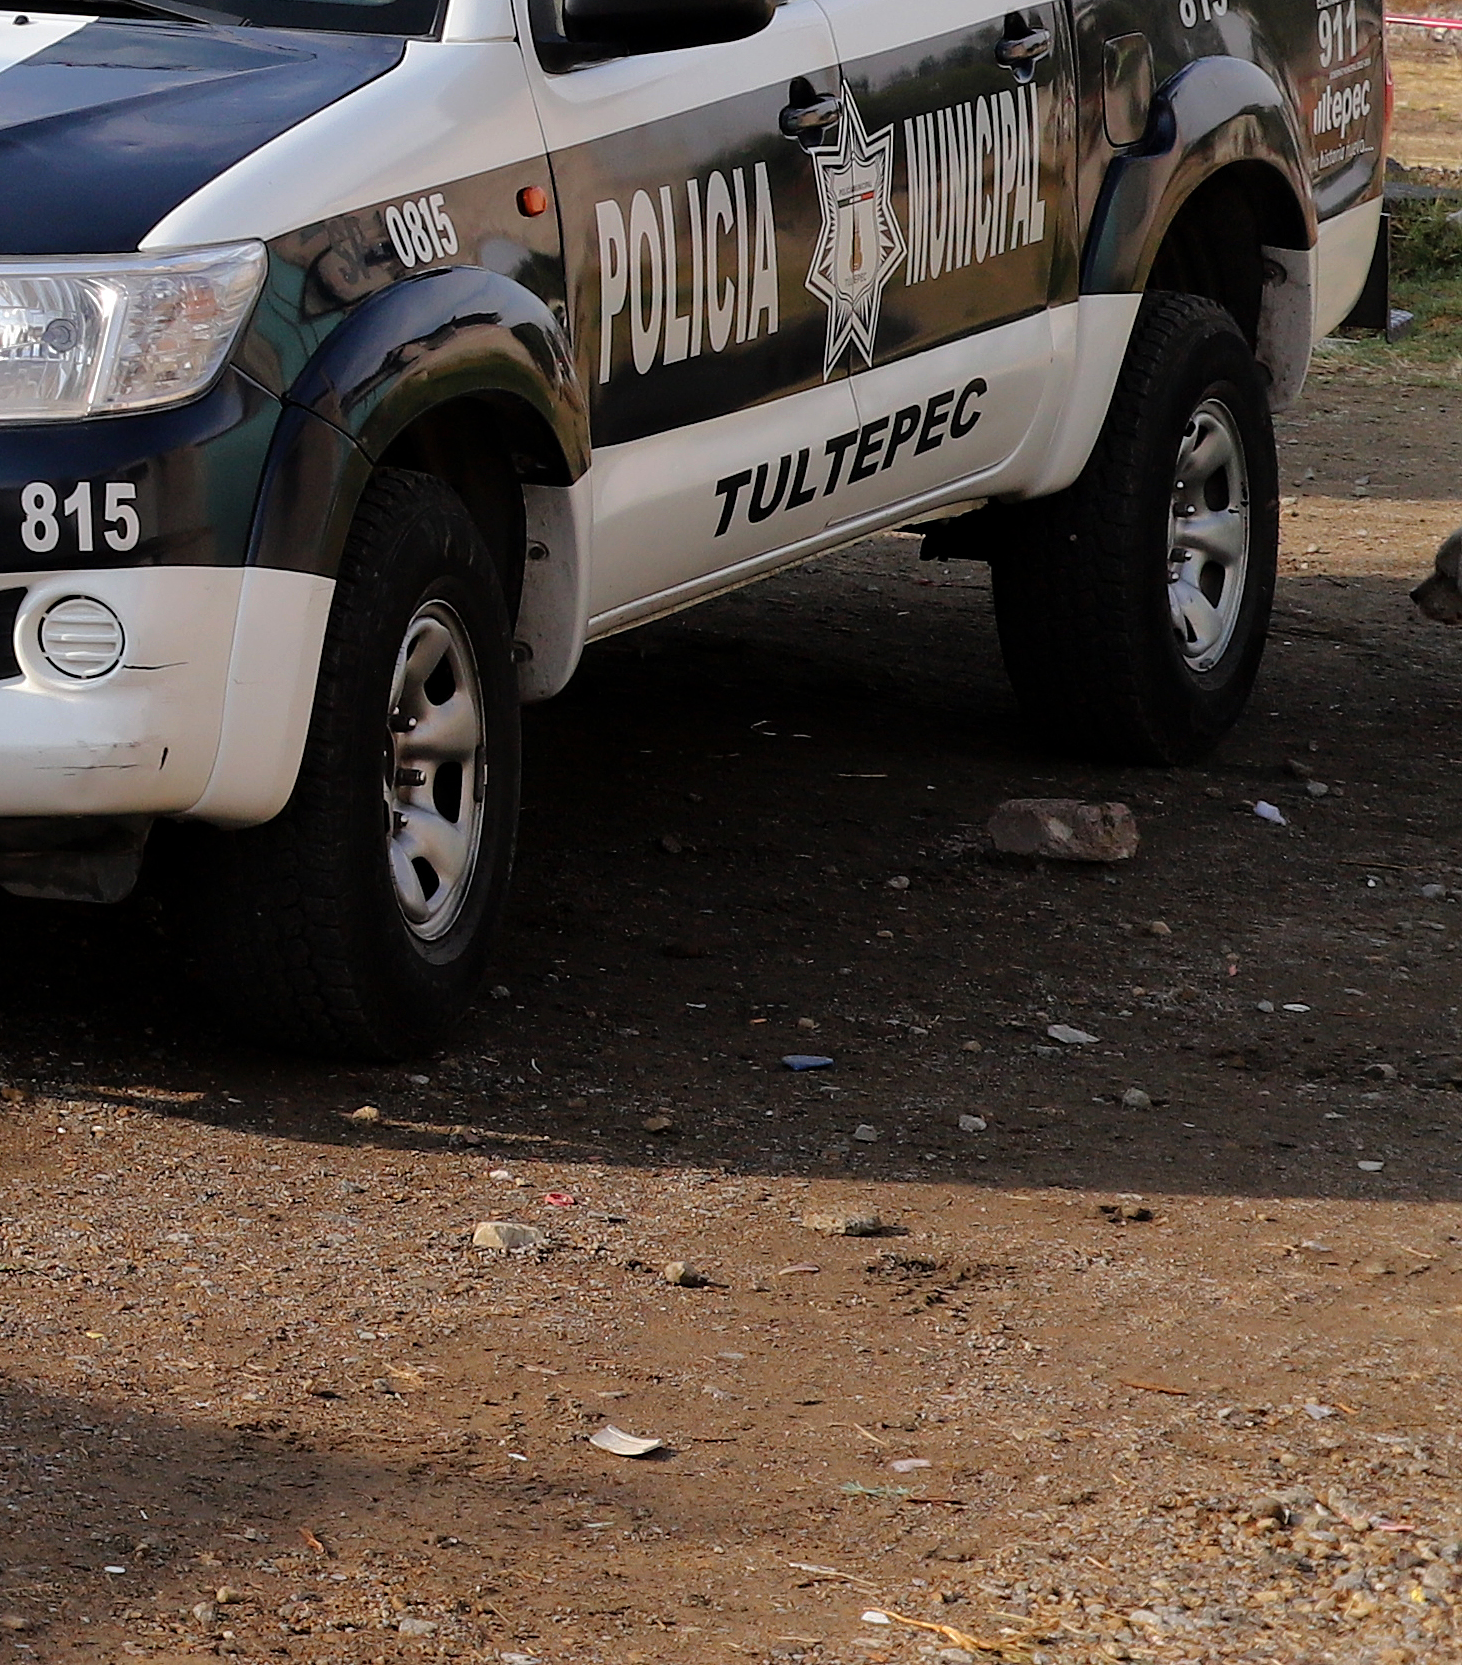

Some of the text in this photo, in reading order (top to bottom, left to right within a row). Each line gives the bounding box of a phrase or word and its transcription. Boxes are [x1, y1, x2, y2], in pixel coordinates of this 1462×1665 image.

[1318, 0, 1357, 68] 911
[385, 193, 459, 268] 0815
[595, 82, 1045, 385] POLICIA MUNICIPAL
[714, 377, 988, 538] TULTEPEC
[21, 481, 140, 552] 815
